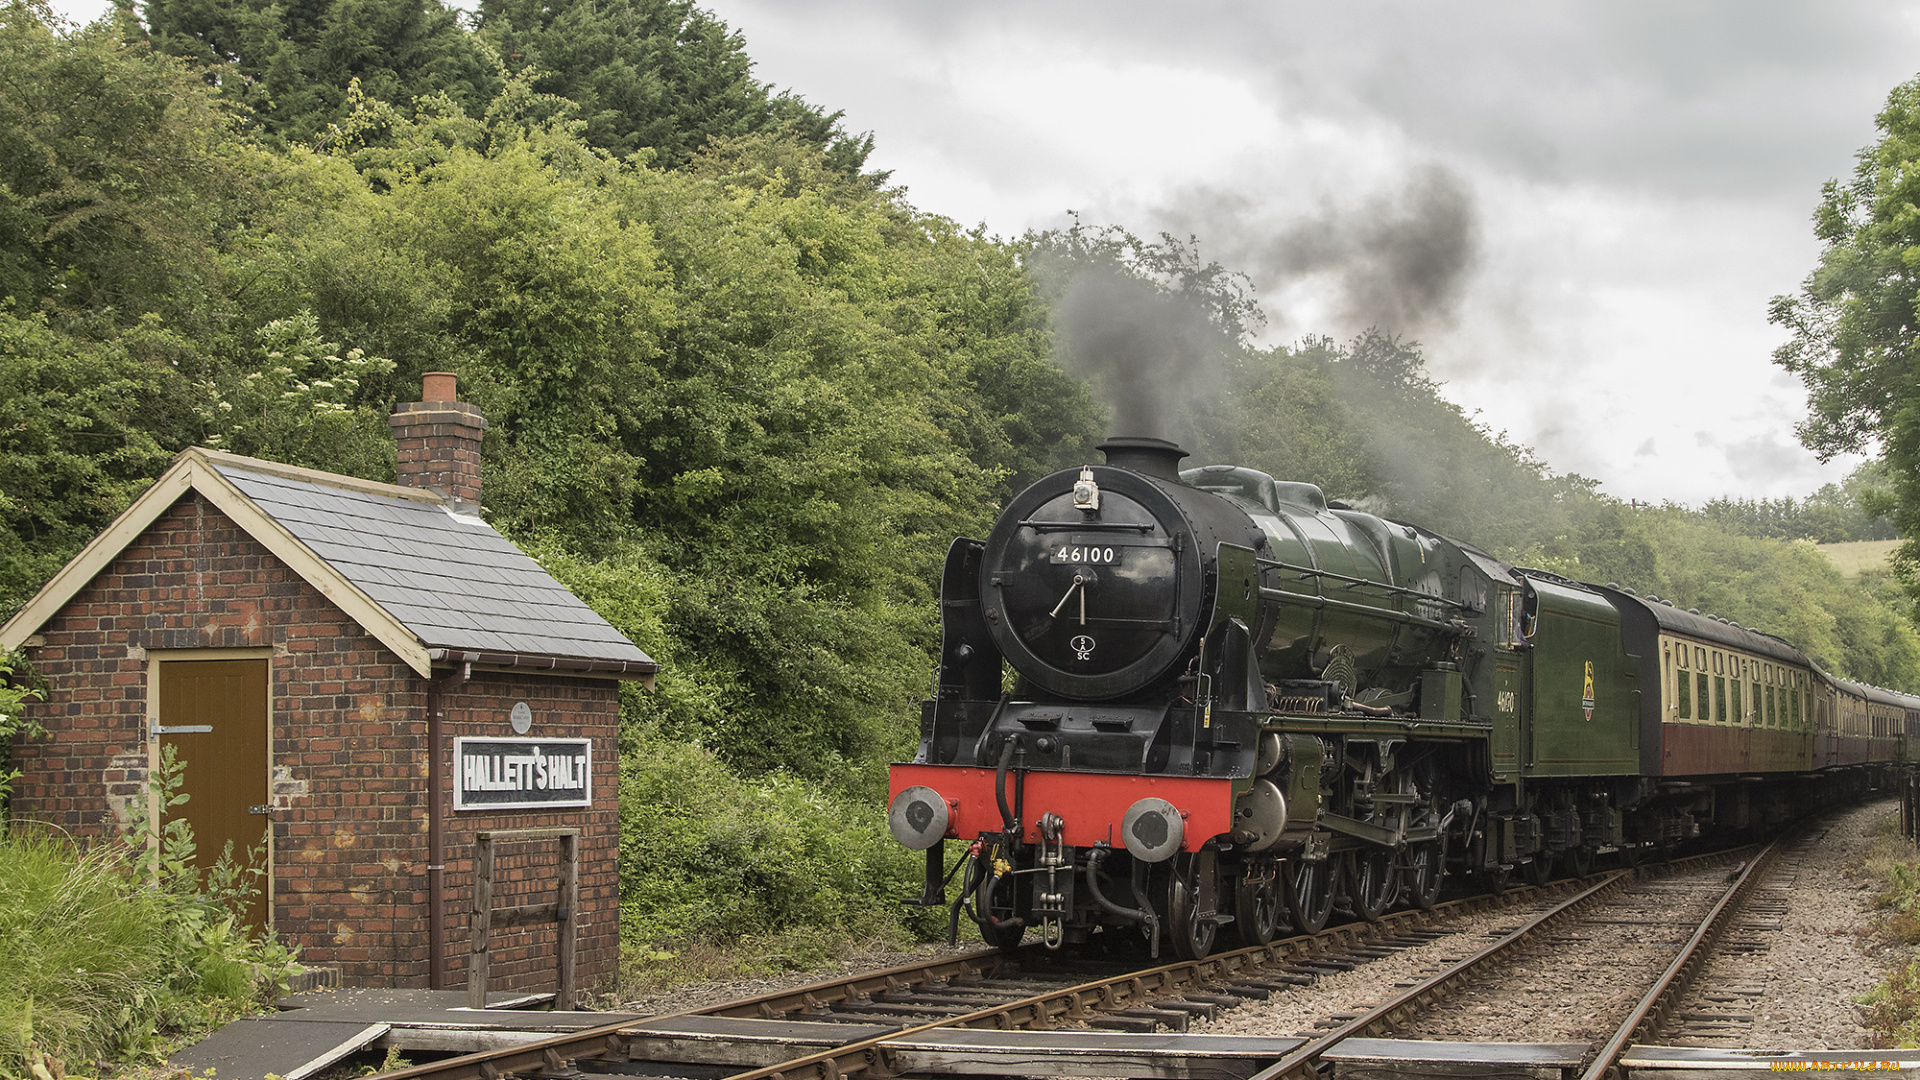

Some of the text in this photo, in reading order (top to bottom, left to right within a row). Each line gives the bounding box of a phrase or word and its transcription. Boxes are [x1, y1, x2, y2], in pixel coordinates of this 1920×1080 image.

[1057, 547, 1114, 562] 46100
[1077, 652, 1090, 660] SC
[463, 746, 586, 791] HALLETT'S HALT
